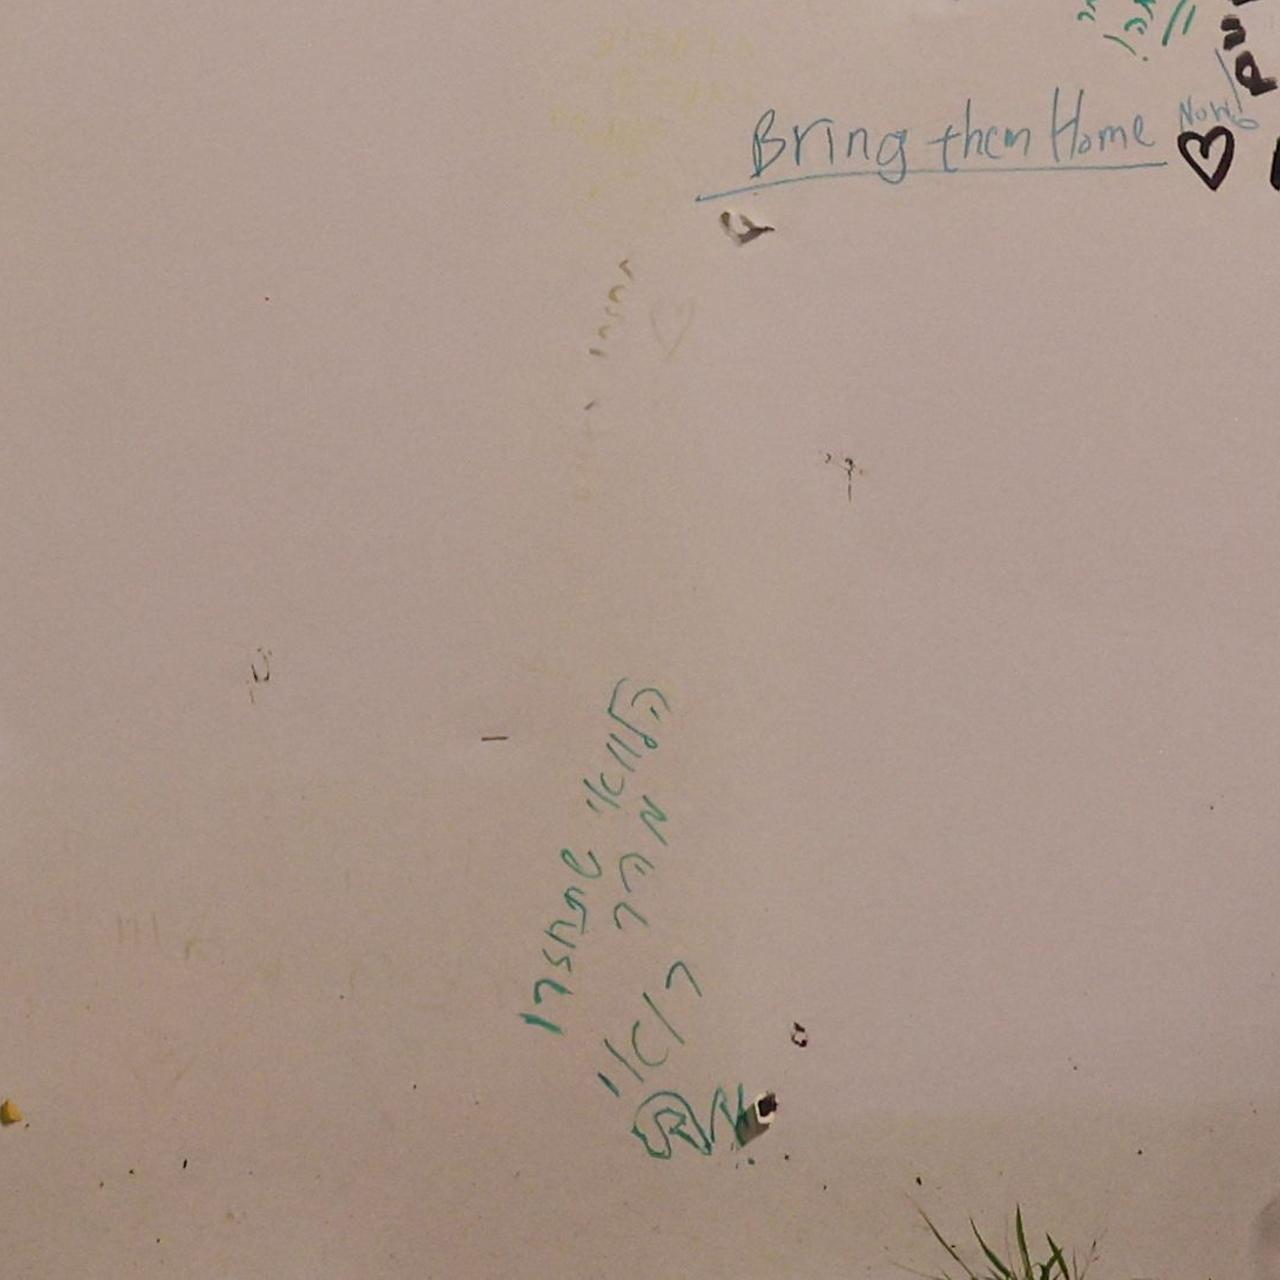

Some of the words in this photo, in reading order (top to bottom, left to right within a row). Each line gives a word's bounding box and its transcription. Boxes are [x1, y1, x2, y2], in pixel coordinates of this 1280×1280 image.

[750, 109, 908, 185] Bring
[929, 98, 1031, 173] them
[1050, 87, 1155, 165] Home
